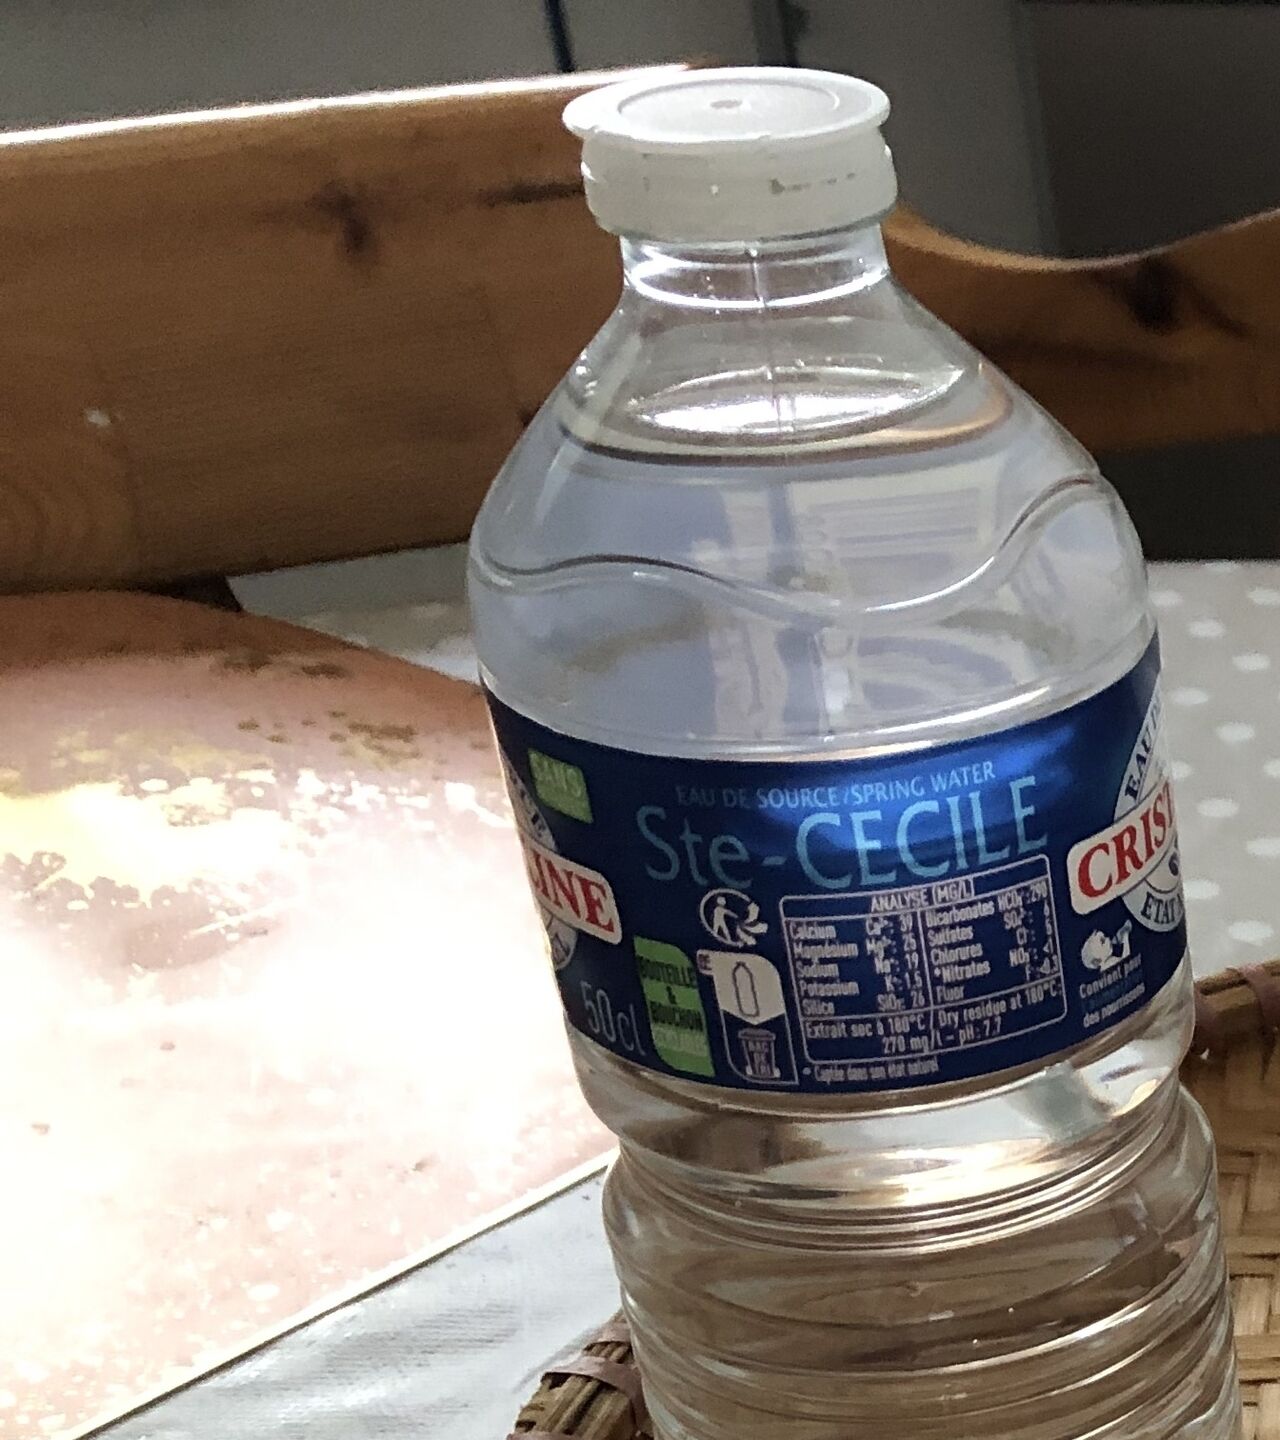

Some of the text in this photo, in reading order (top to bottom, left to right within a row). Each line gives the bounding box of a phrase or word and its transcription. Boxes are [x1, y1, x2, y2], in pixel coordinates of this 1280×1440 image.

[674, 784, 718, 809] EAU
[721, 786, 752, 809] DE
[930, 759, 997, 794] WATER
[871, 888, 930, 913] ANALYSE
[806, 1022, 847, 1040] Extrait
[851, 1022, 872, 1037] sec
[938, 1010, 959, 1028] Dry
